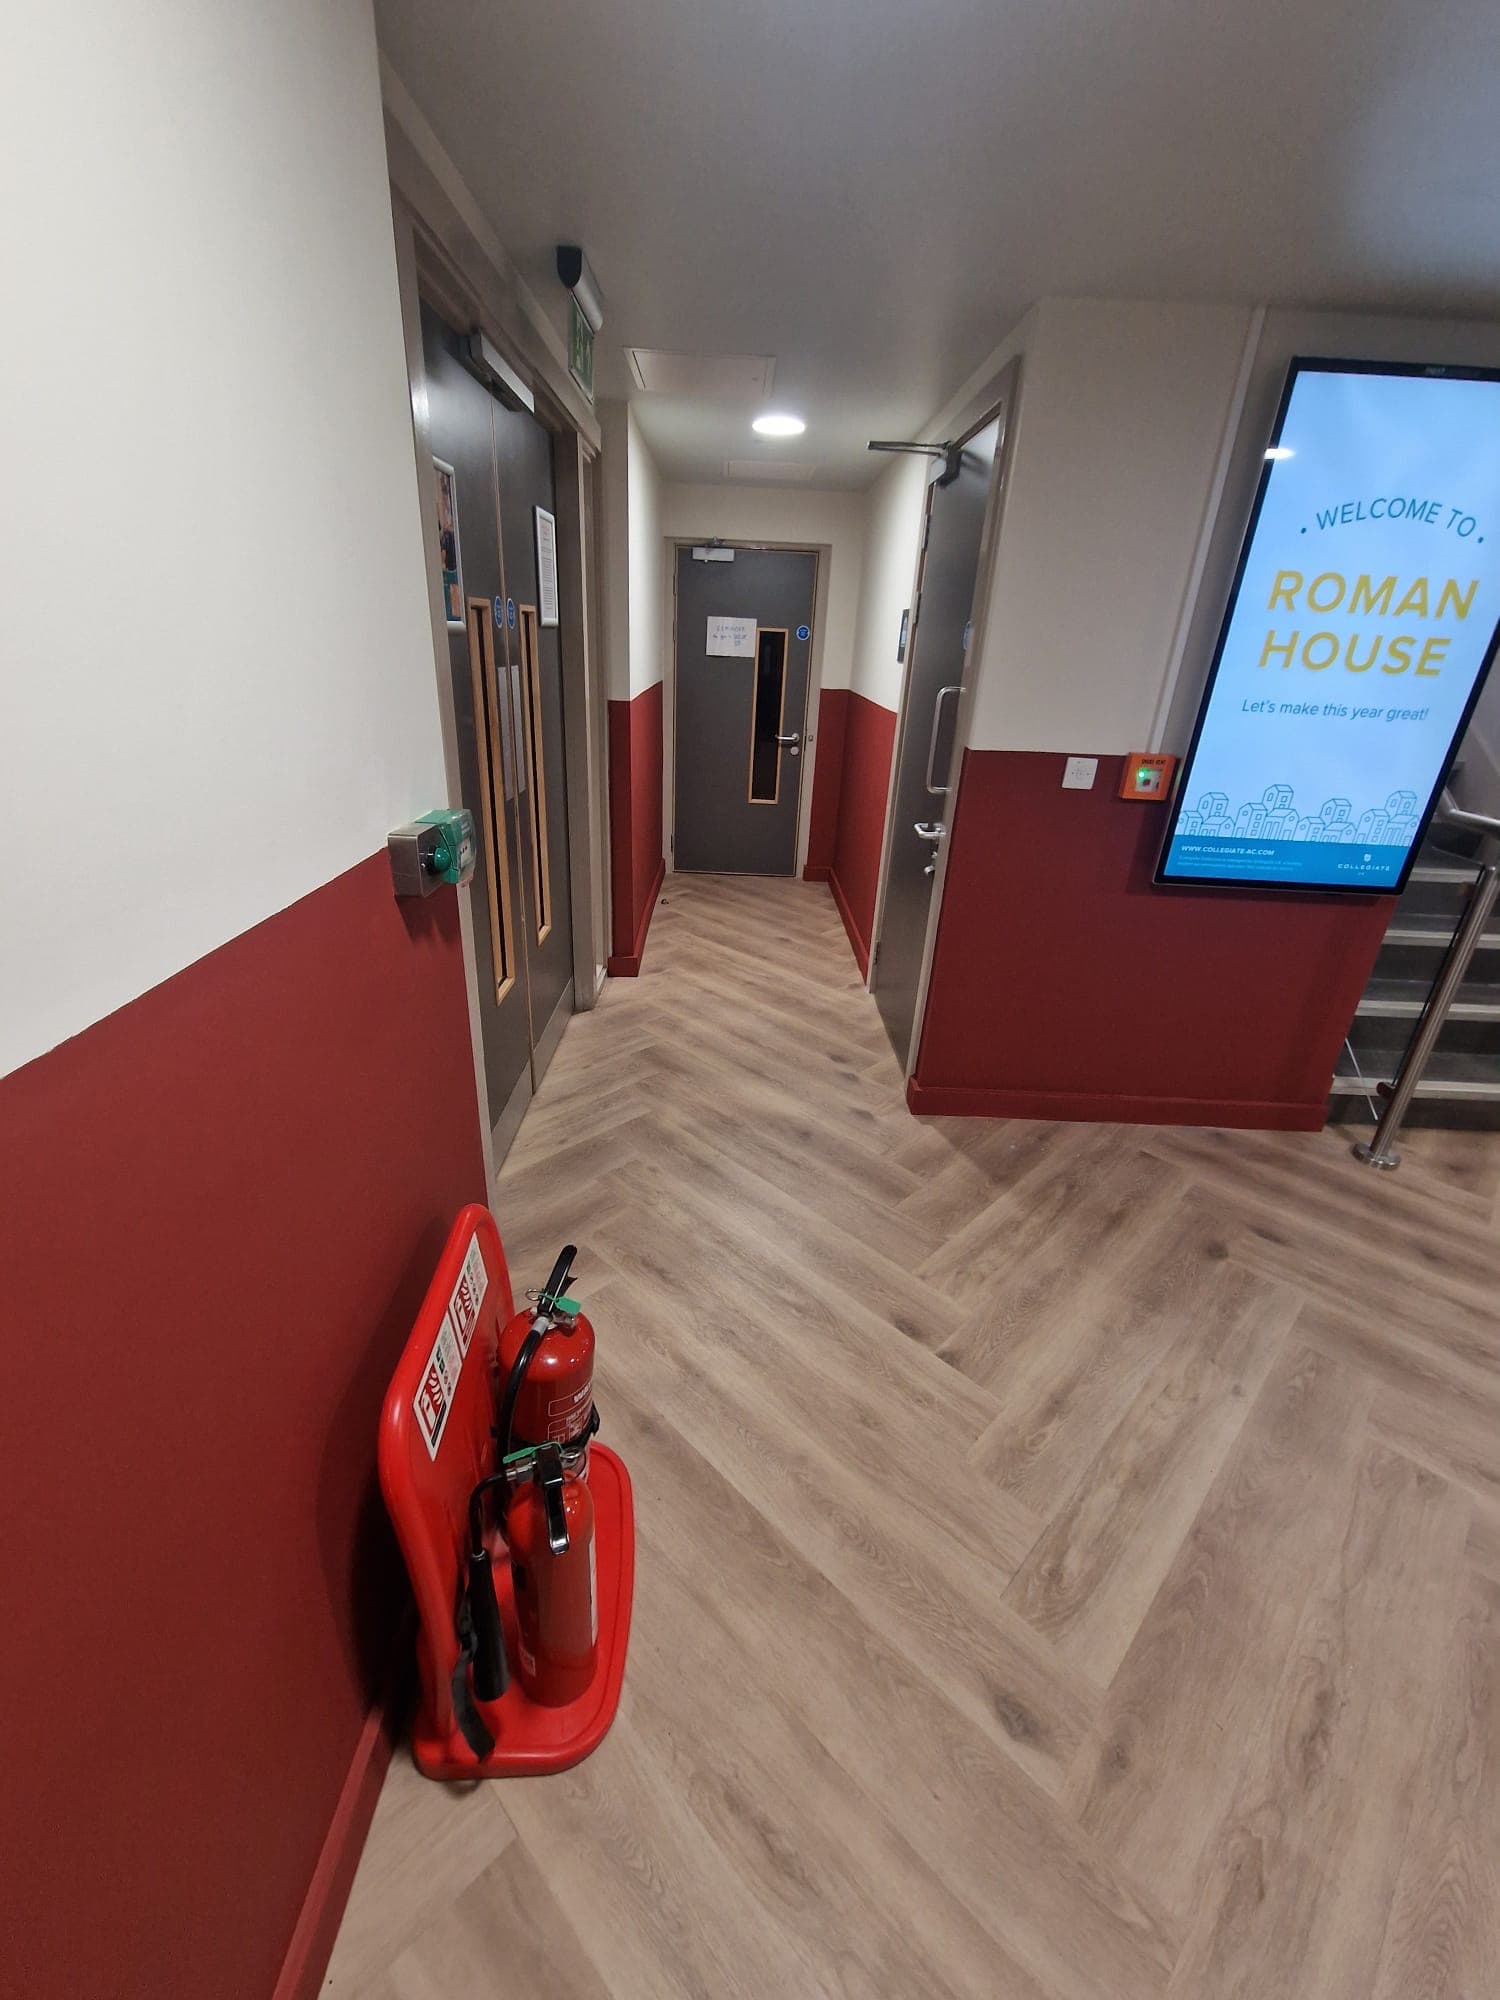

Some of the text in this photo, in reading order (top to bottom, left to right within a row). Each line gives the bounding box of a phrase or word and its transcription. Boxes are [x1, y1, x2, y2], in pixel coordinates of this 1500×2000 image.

[1316, 498, 1476, 537] WELCOME TO
[1267, 570, 1479, 620] ROMAN
[1257, 630, 1452, 676] HOUSE
[1241, 699, 1429, 722] Let's make this year great!
[1337, 863, 1390, 872] COLLEGIATE
